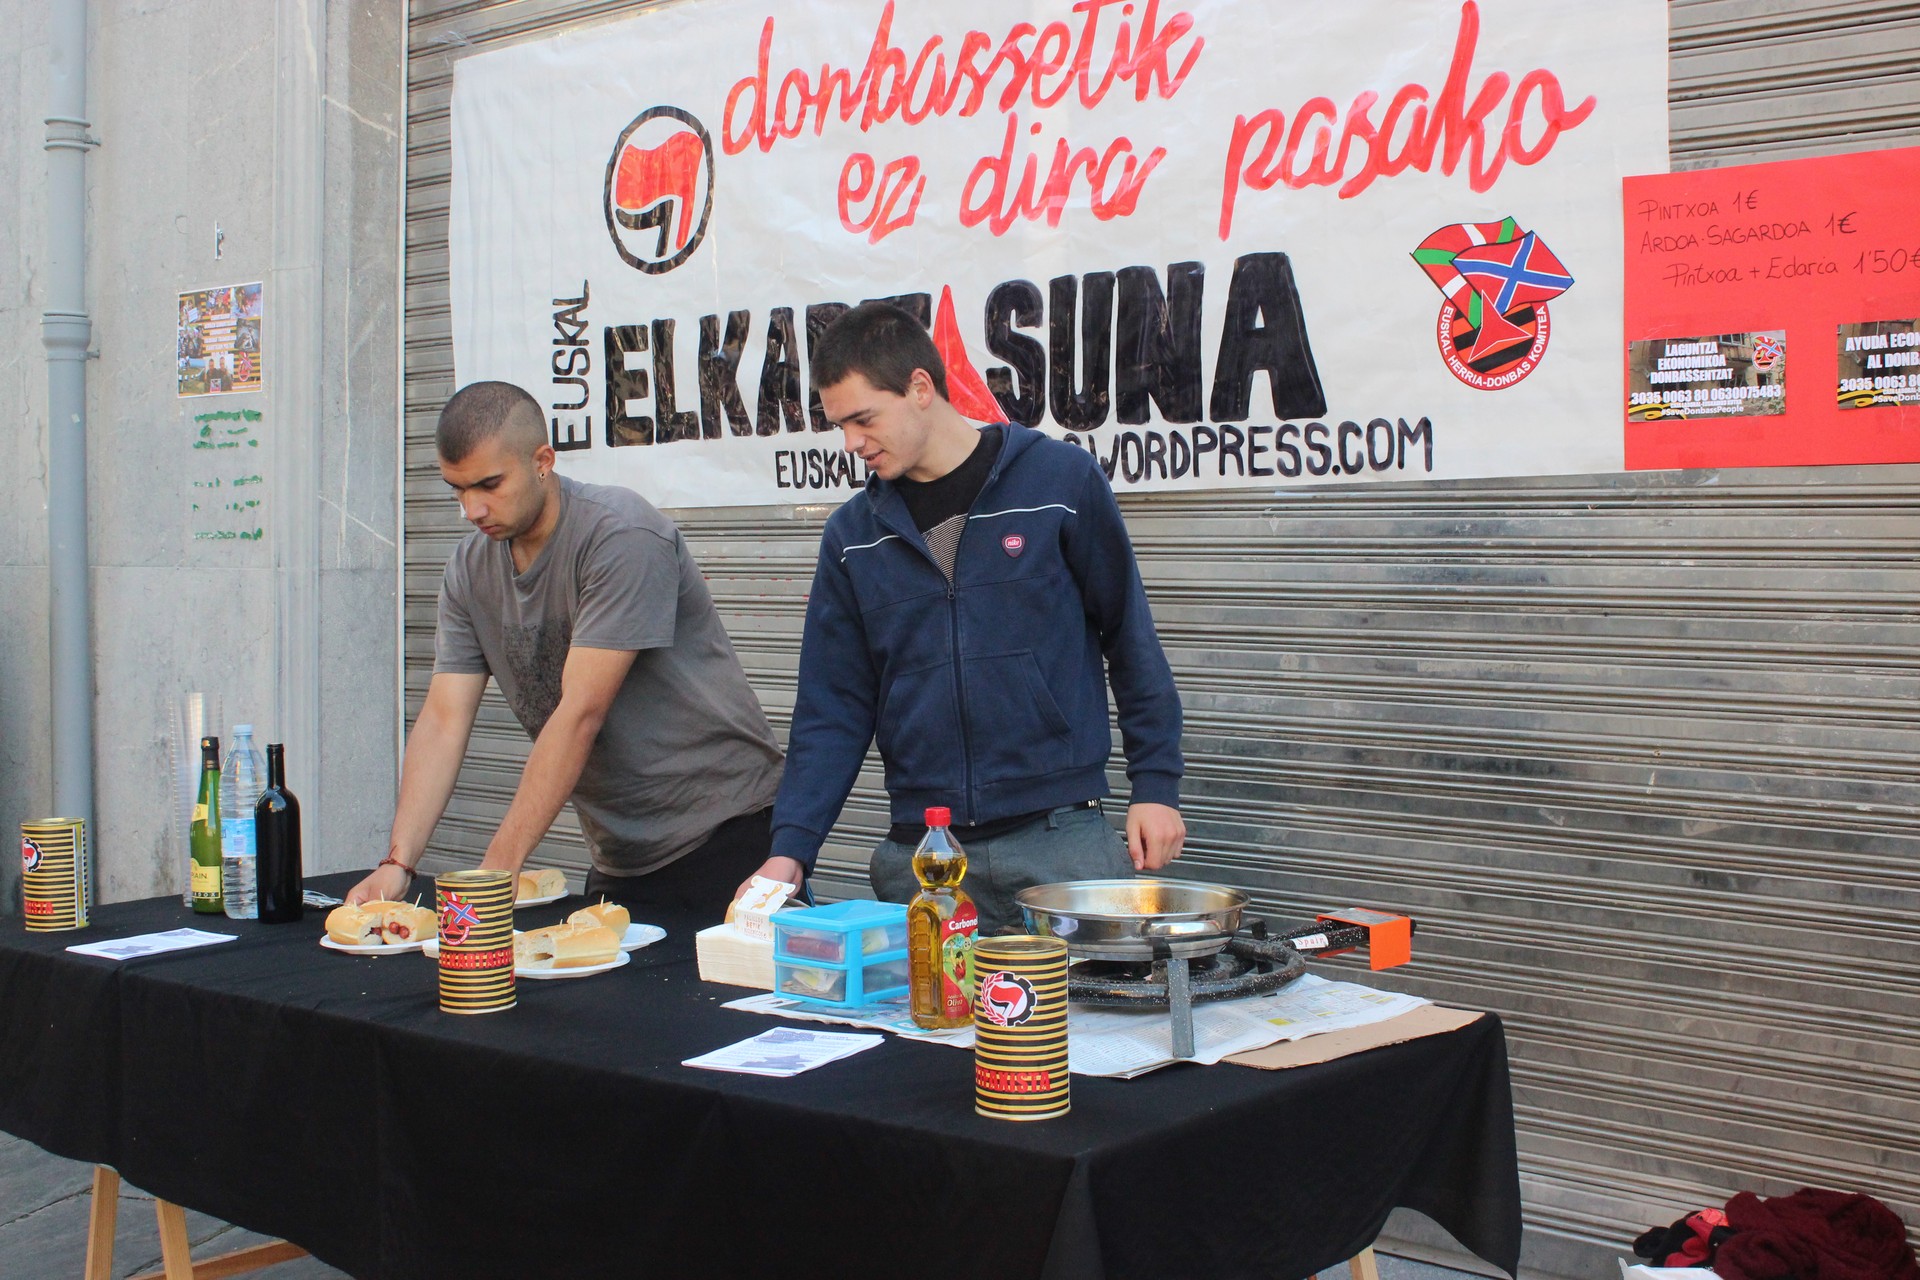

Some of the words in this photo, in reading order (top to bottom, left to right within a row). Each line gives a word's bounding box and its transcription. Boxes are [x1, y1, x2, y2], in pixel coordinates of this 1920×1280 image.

[722, 0, 1206, 156] donbassetik
[837, 152, 927, 245] ez
[959, 111, 1168, 238] dira
[1218, 0, 1598, 241] pasako
[1638, 199, 1719, 222] PINTXOA
[1662, 262, 1744, 287] Pintxoa
[1440, 305, 1454, 356] EUSKAL
[1528, 305, 1548, 363] KOMITEA
[1845, 334, 1889, 352] AYUDA
[1664, 341, 1719, 357] LAGUNTZA
[1866, 354, 1883, 369] AL
[1884, 351, 1920, 368] DONB
[551, 279, 592, 452] EUSKAL
[1657, 354, 1727, 370] EKONOMIKOA
[1650, 368, 1734, 384] DONBASSENTZAT
[1840, 377, 1873, 392] 3035
[1874, 374, 1907, 390] 0063
[1631, 391, 1661, 405] 3035
[1662, 389, 1692, 403] 0063
[1693, 388, 1709, 402] 80
[1710, 384, 1782, 401] 0630075483
[775, 447, 873, 491] EUSKAL
